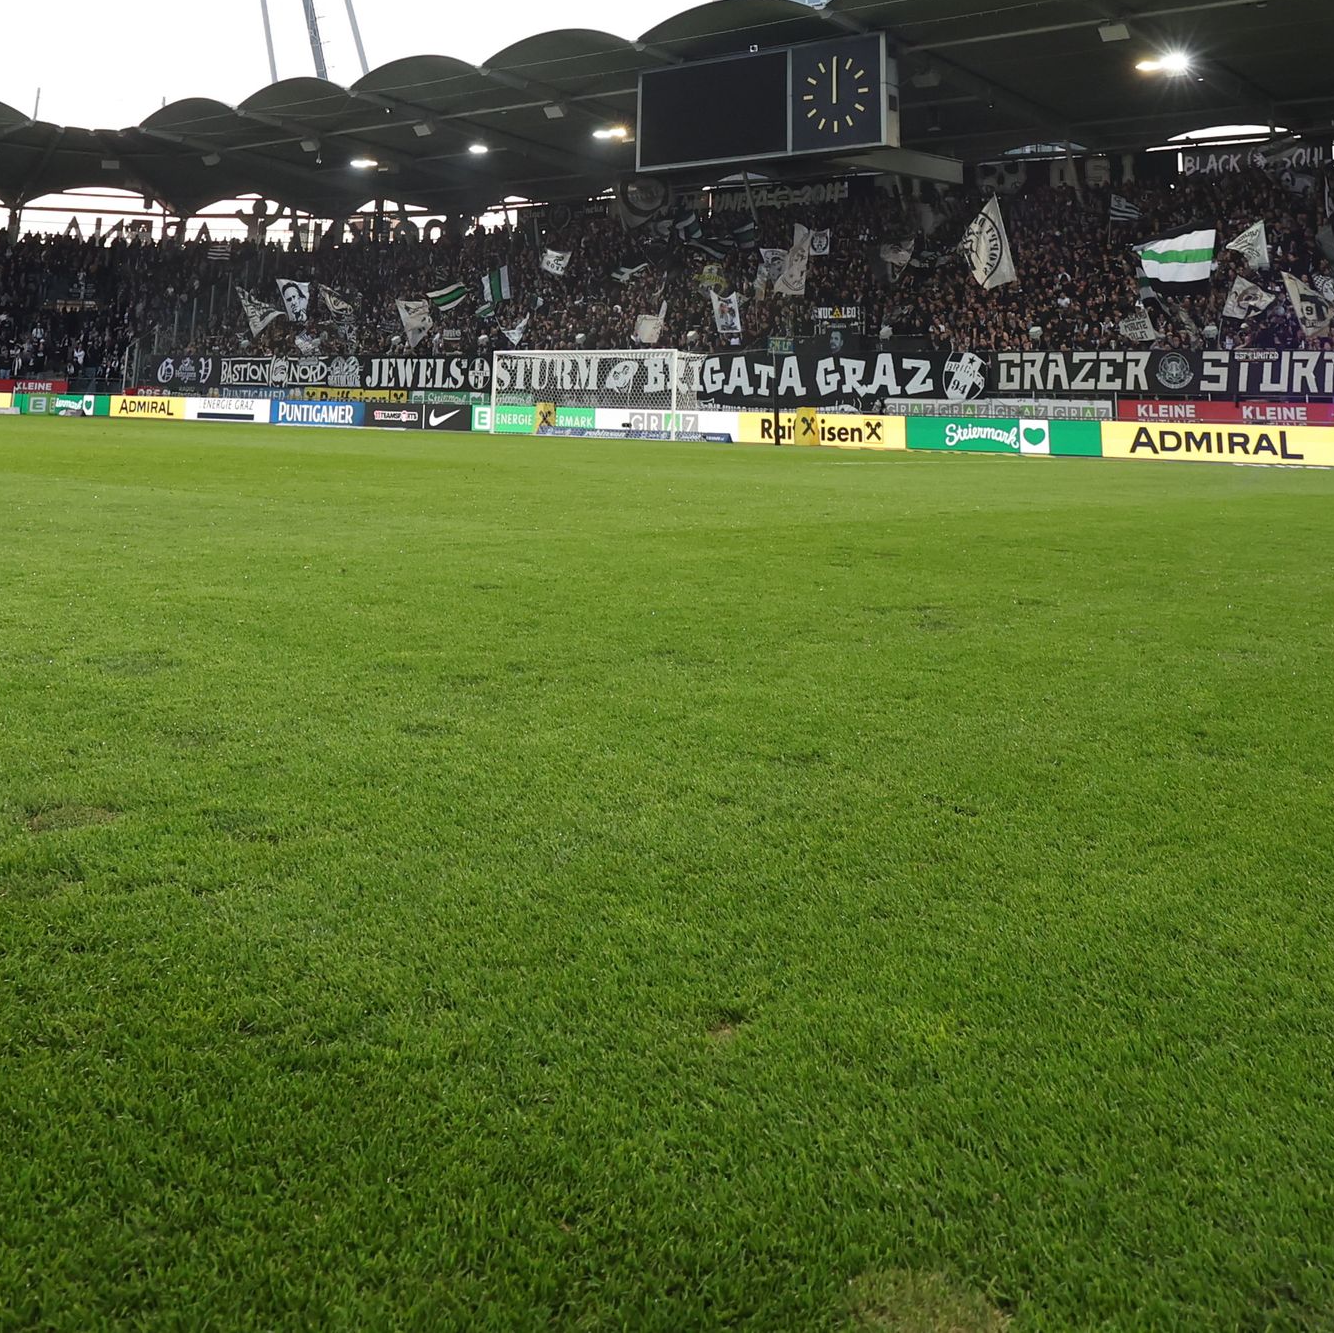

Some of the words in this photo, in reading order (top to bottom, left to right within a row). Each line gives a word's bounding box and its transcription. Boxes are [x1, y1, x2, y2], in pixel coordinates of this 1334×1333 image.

[1183, 152, 1242, 177] BLACK
[220, 360, 270, 384] BASTION
[288, 360, 328, 382] NORD
[497, 358, 598, 391] STURM
[644, 354, 806, 397] BRIGATA
[816, 352, 934, 397] GRAZ
[998, 351, 1152, 391] GRAZER
[951, 378, 968, 395] 94
[119, 398, 174, 416] ADMIRAL
[203, 399, 233, 410] ENERGIE
[234, 400, 255, 411] GRAZ
[278, 401, 354, 425] PUNTIGAMER
[1137, 404, 1196, 419] KLEINE
[1242, 405, 1308, 421] KLEINE
[496, 412, 533, 425] ENERGIE
[945, 423, 1020, 449] Steiermark
[1129, 427, 1304, 460] ADMIRAL
